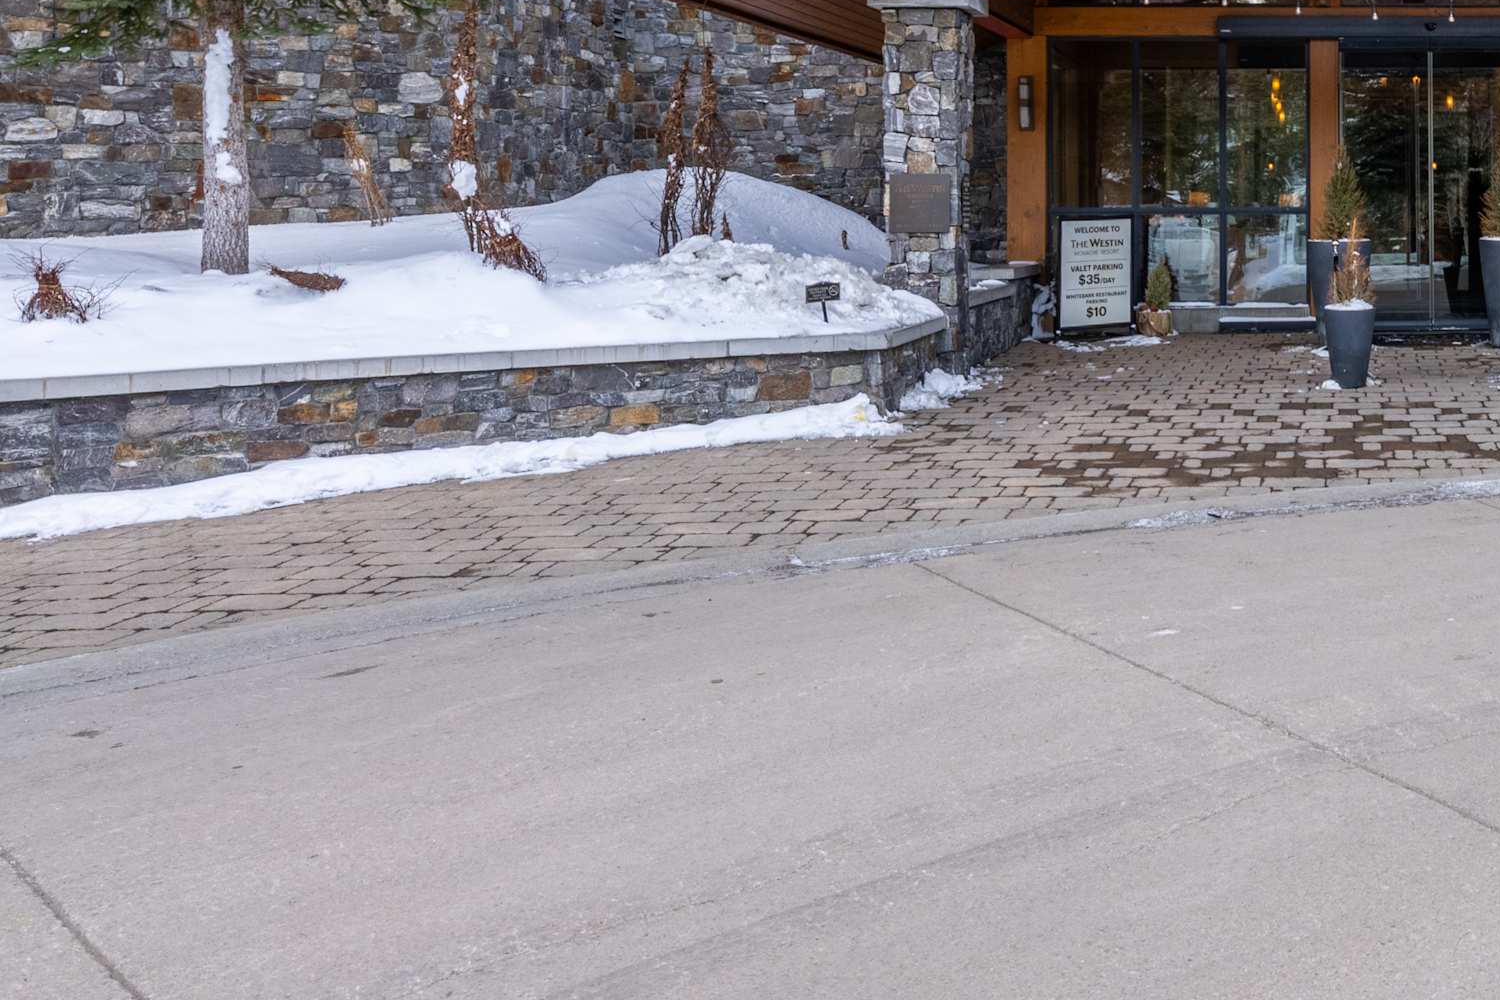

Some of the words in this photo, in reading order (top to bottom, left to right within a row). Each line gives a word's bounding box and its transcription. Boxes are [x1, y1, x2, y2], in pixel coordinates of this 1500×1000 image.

[1074, 226, 1109, 234] WELCOME
[1070, 239, 1088, 248] THE
[1089, 238, 1124, 248] WESTIN
[1070, 264, 1091, 272] VALET
[1093, 263, 1123, 271] PARKING
[1086, 306, 1107, 318] $10
